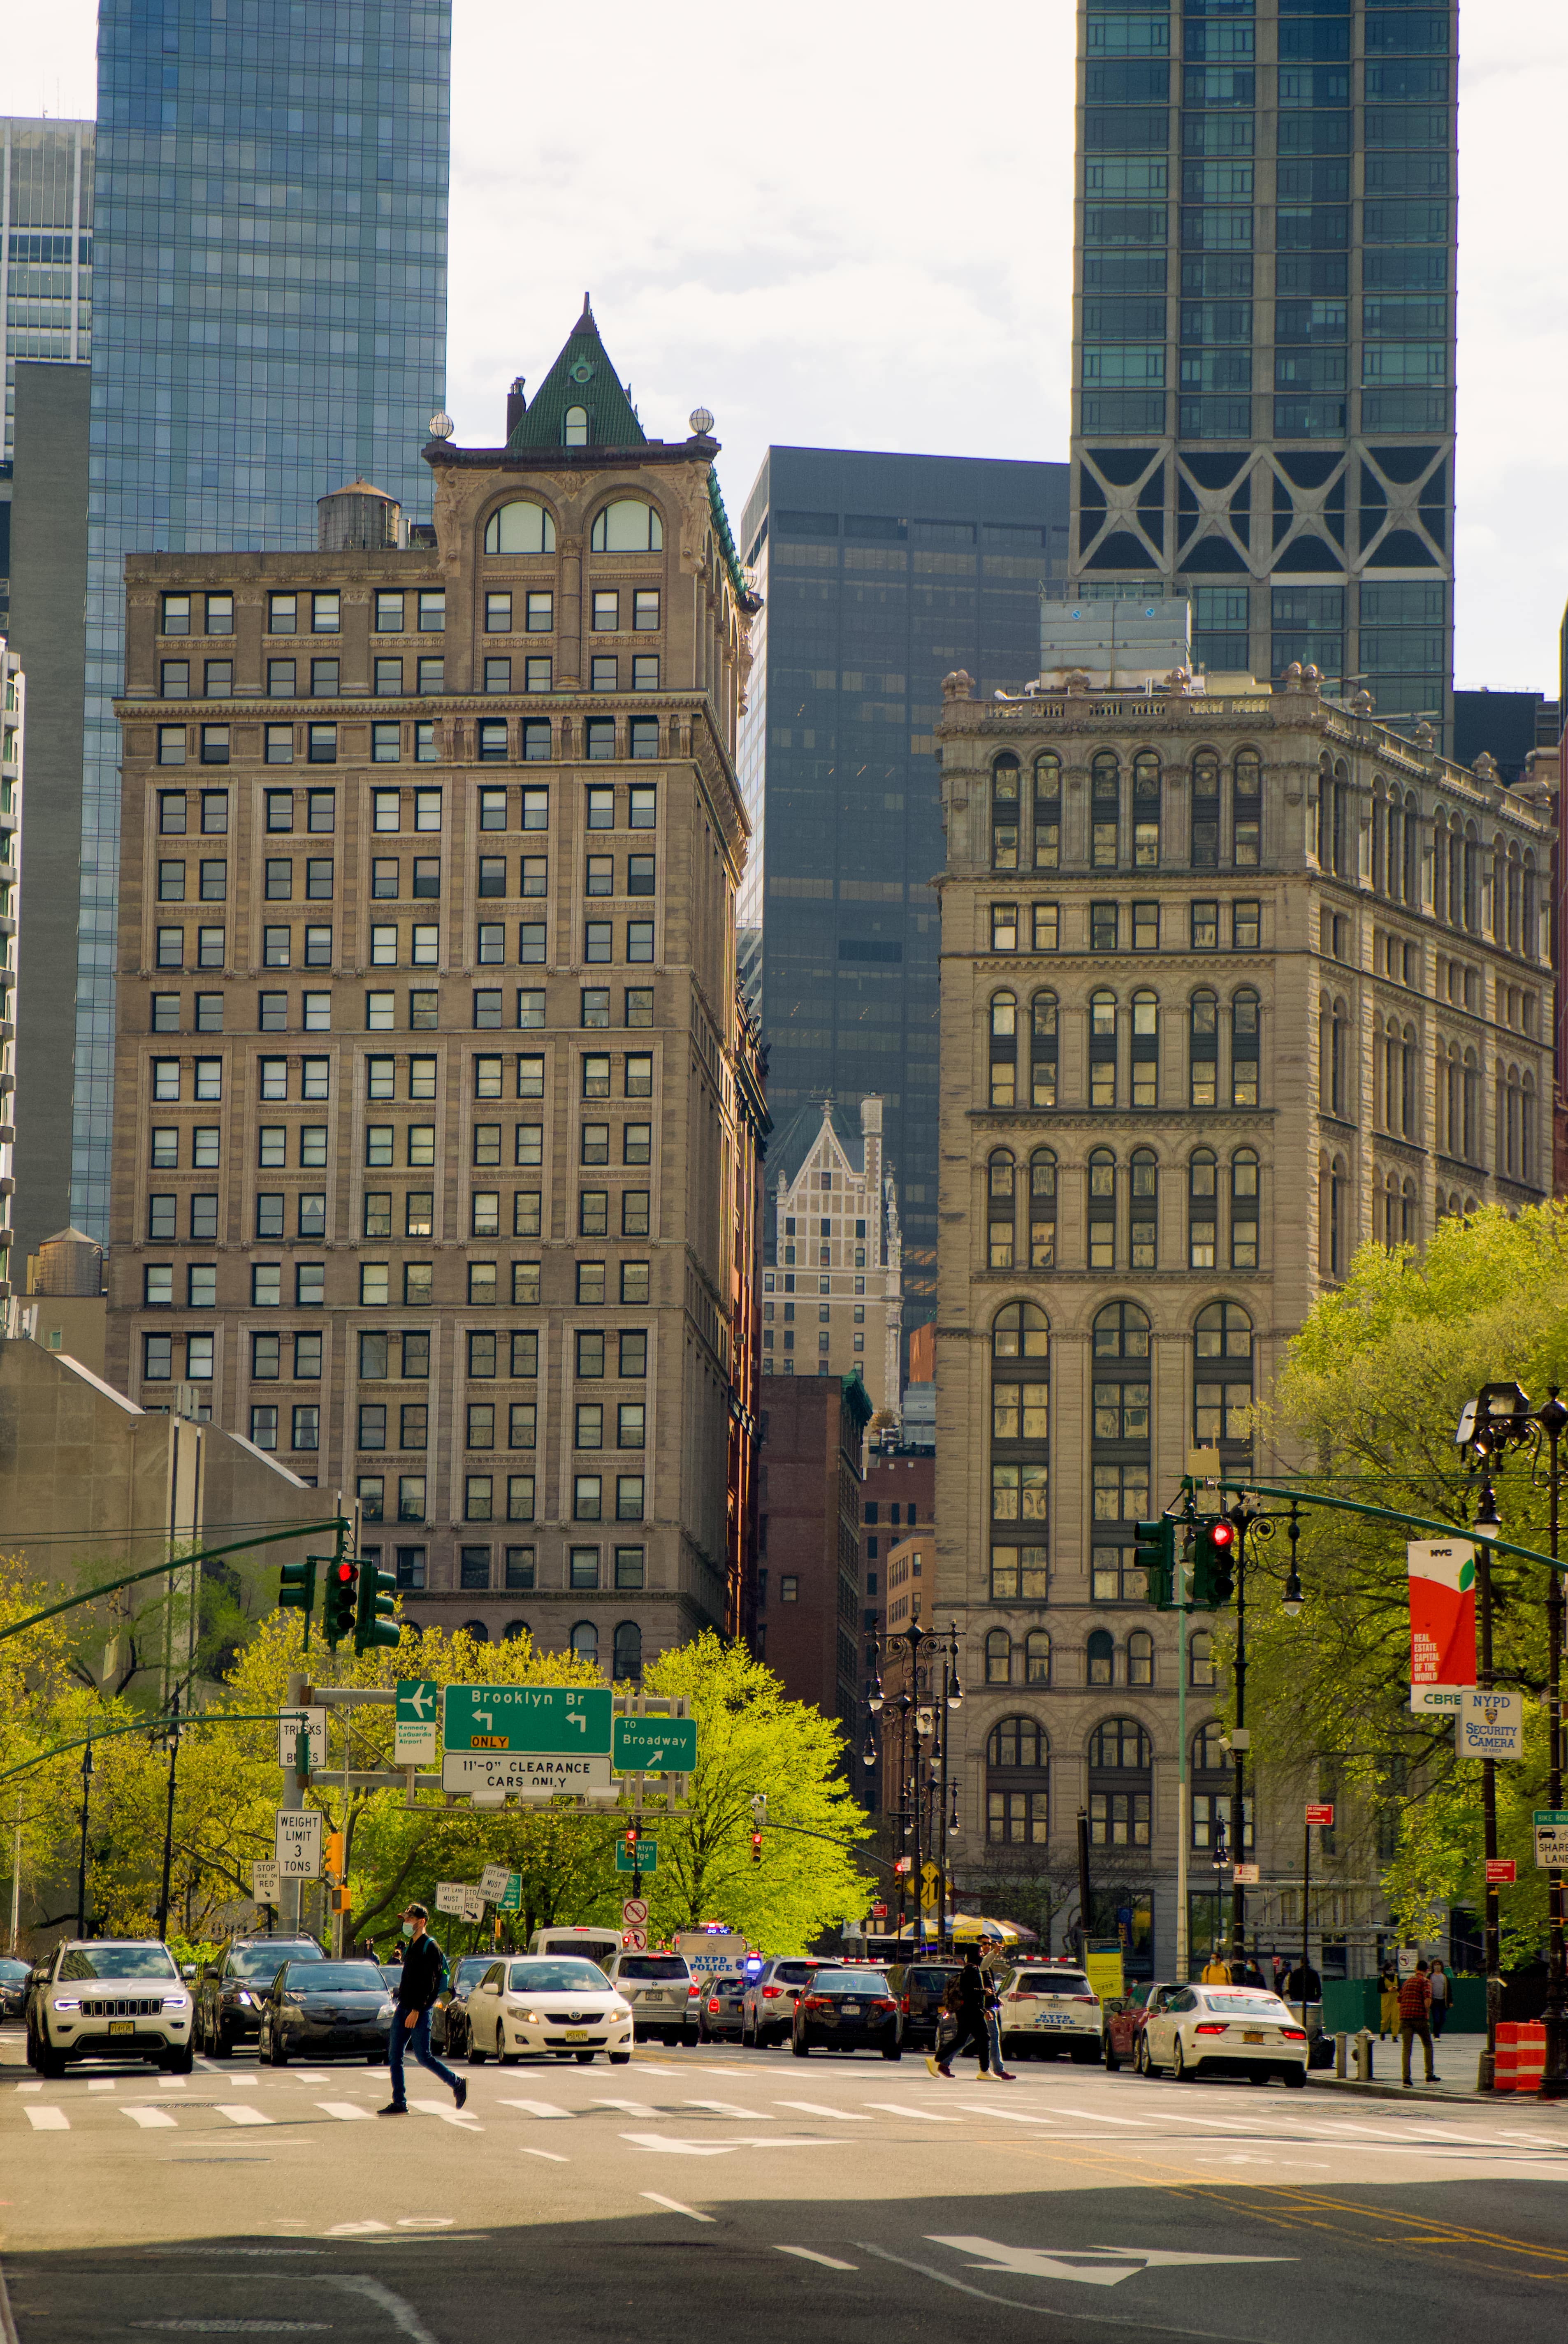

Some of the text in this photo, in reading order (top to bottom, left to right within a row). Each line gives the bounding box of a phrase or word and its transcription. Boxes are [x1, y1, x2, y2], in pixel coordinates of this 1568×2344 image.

[1414, 1634, 1429, 1643] REAL
[1414, 1643, 1437, 1653] ESTATE
[1414, 1653, 1440, 1662] CAPITAL
[1414, 1662, 1436, 1672] OF THE
[1414, 1672, 1438, 1681] WORLD
[472, 1690, 585, 1707] Brooklyn Br
[1424, 1693, 1461, 1705] CBRE
[1473, 1695, 1510, 1708] NYPD
[1466, 1723, 1517, 1736] SECURITY
[472, 1737, 507, 1747] ONLY
[623, 1734, 687, 1748] Broadway
[1468, 1735, 1515, 1748] CAMERA
[509, 1762, 590, 1774] CLEARANCE
[487, 1777, 523, 1787] CARS
[281, 1817, 318, 1827] WEIGHT
[286, 1831, 311, 1841] LIMIT
[294, 1845, 302, 1857] 3
[620, 1844, 654, 1852] Bklyn
[1538, 1843, 1568, 1852] SHARE
[1545, 1855, 1568, 1863] LANE
[284, 1862, 311, 1871] TONS
[487, 1879, 501, 1889] MUST
